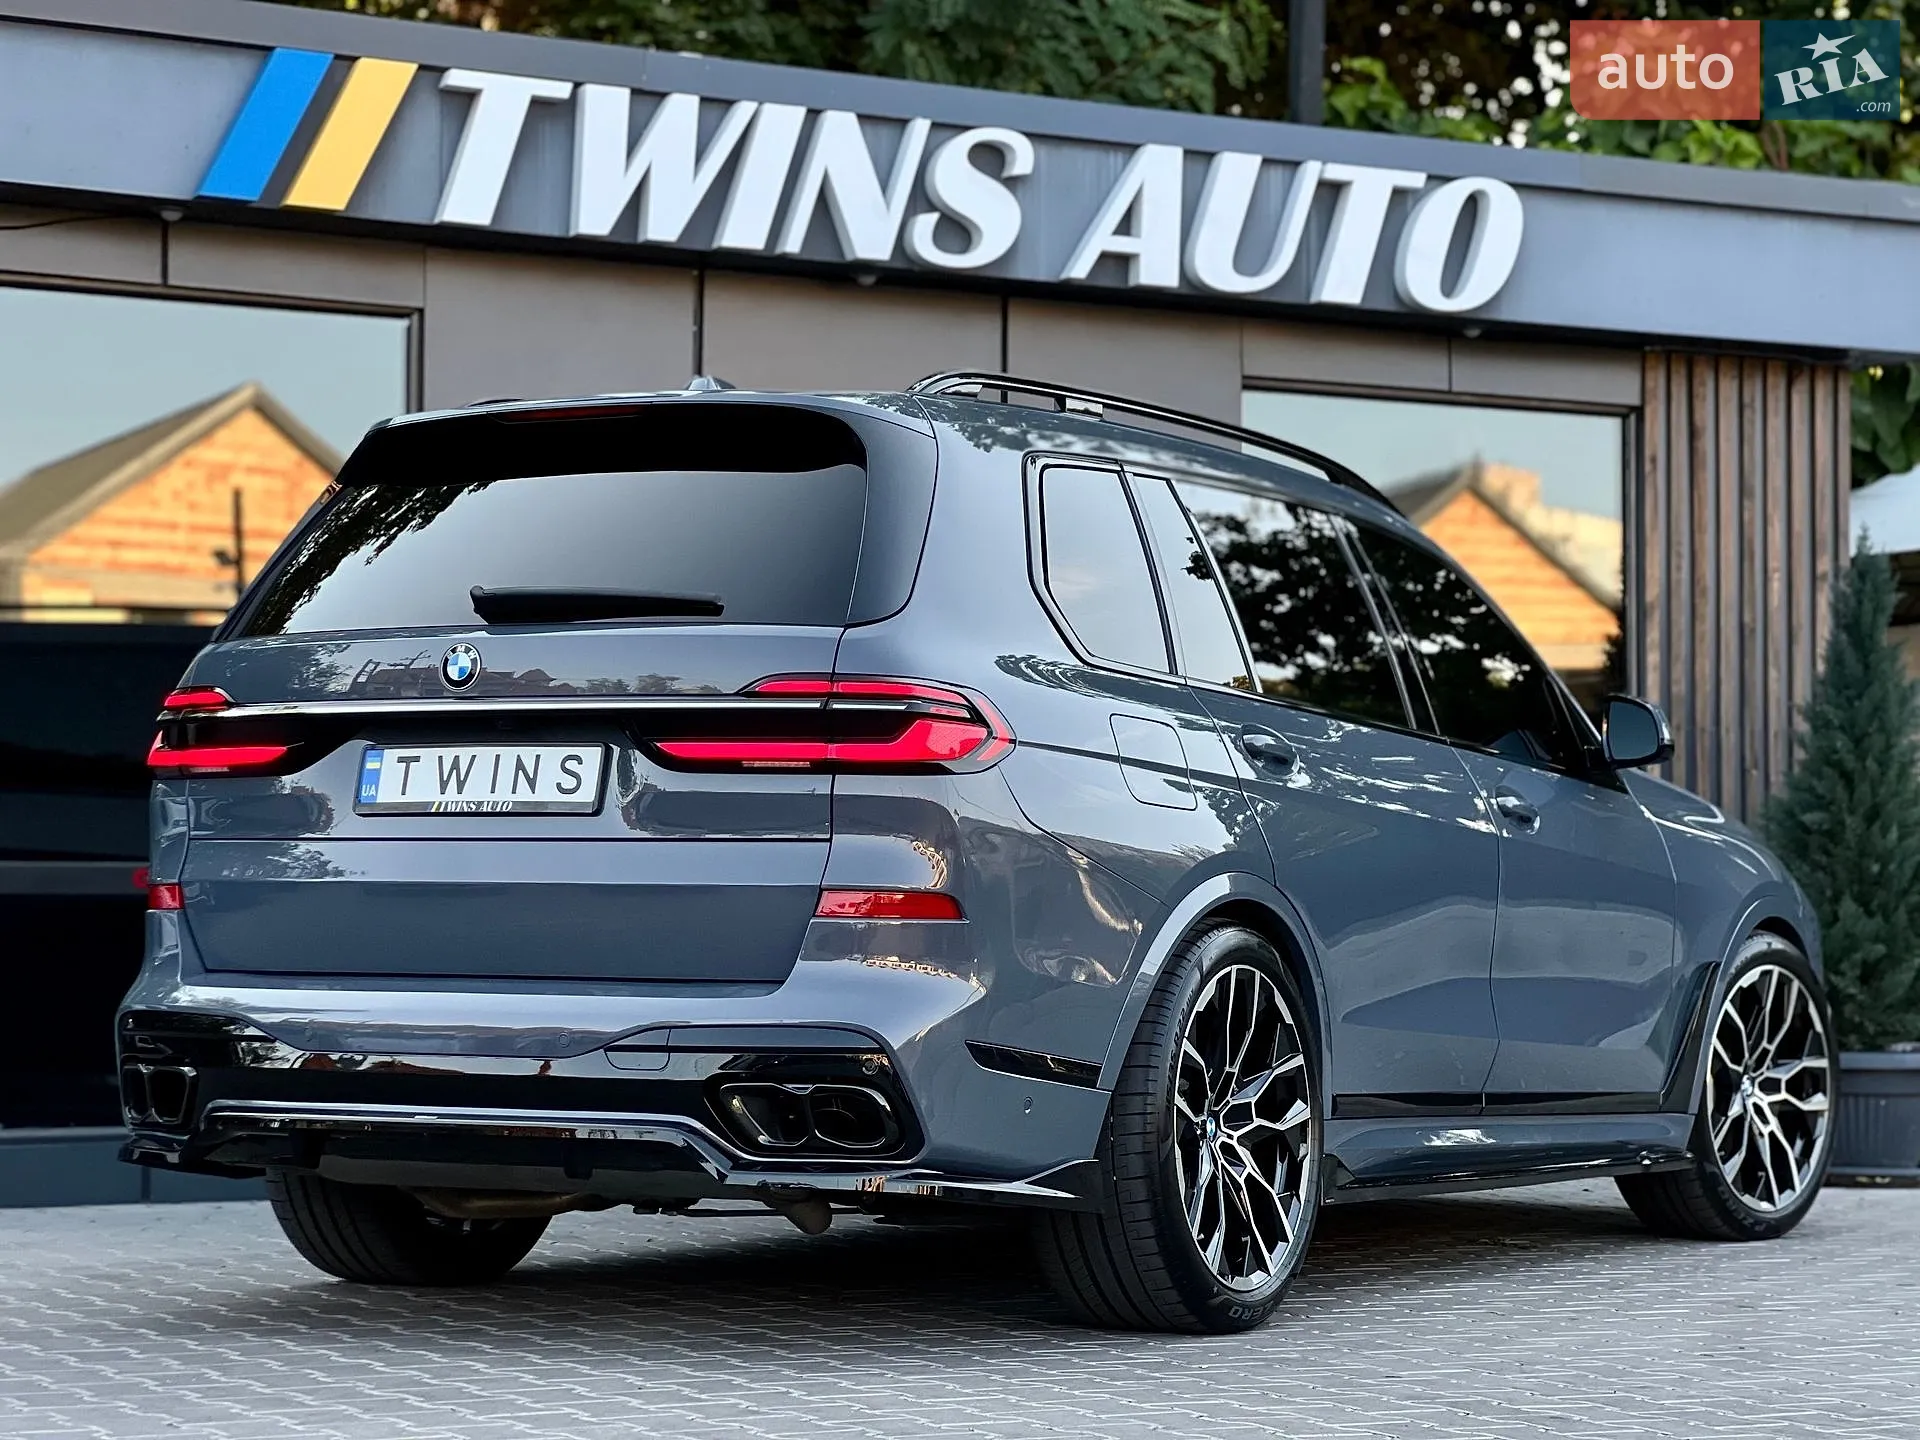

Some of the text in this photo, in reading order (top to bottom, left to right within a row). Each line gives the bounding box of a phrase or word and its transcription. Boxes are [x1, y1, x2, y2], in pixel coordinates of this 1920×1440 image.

[434, 67, 1524, 312] TWINS AUTO
[446, 645, 477, 660] BMW
[396, 754, 584, 796] TWINS
[361, 783, 376, 797] UA
[439, 800, 513, 812] TWINS AUTO
